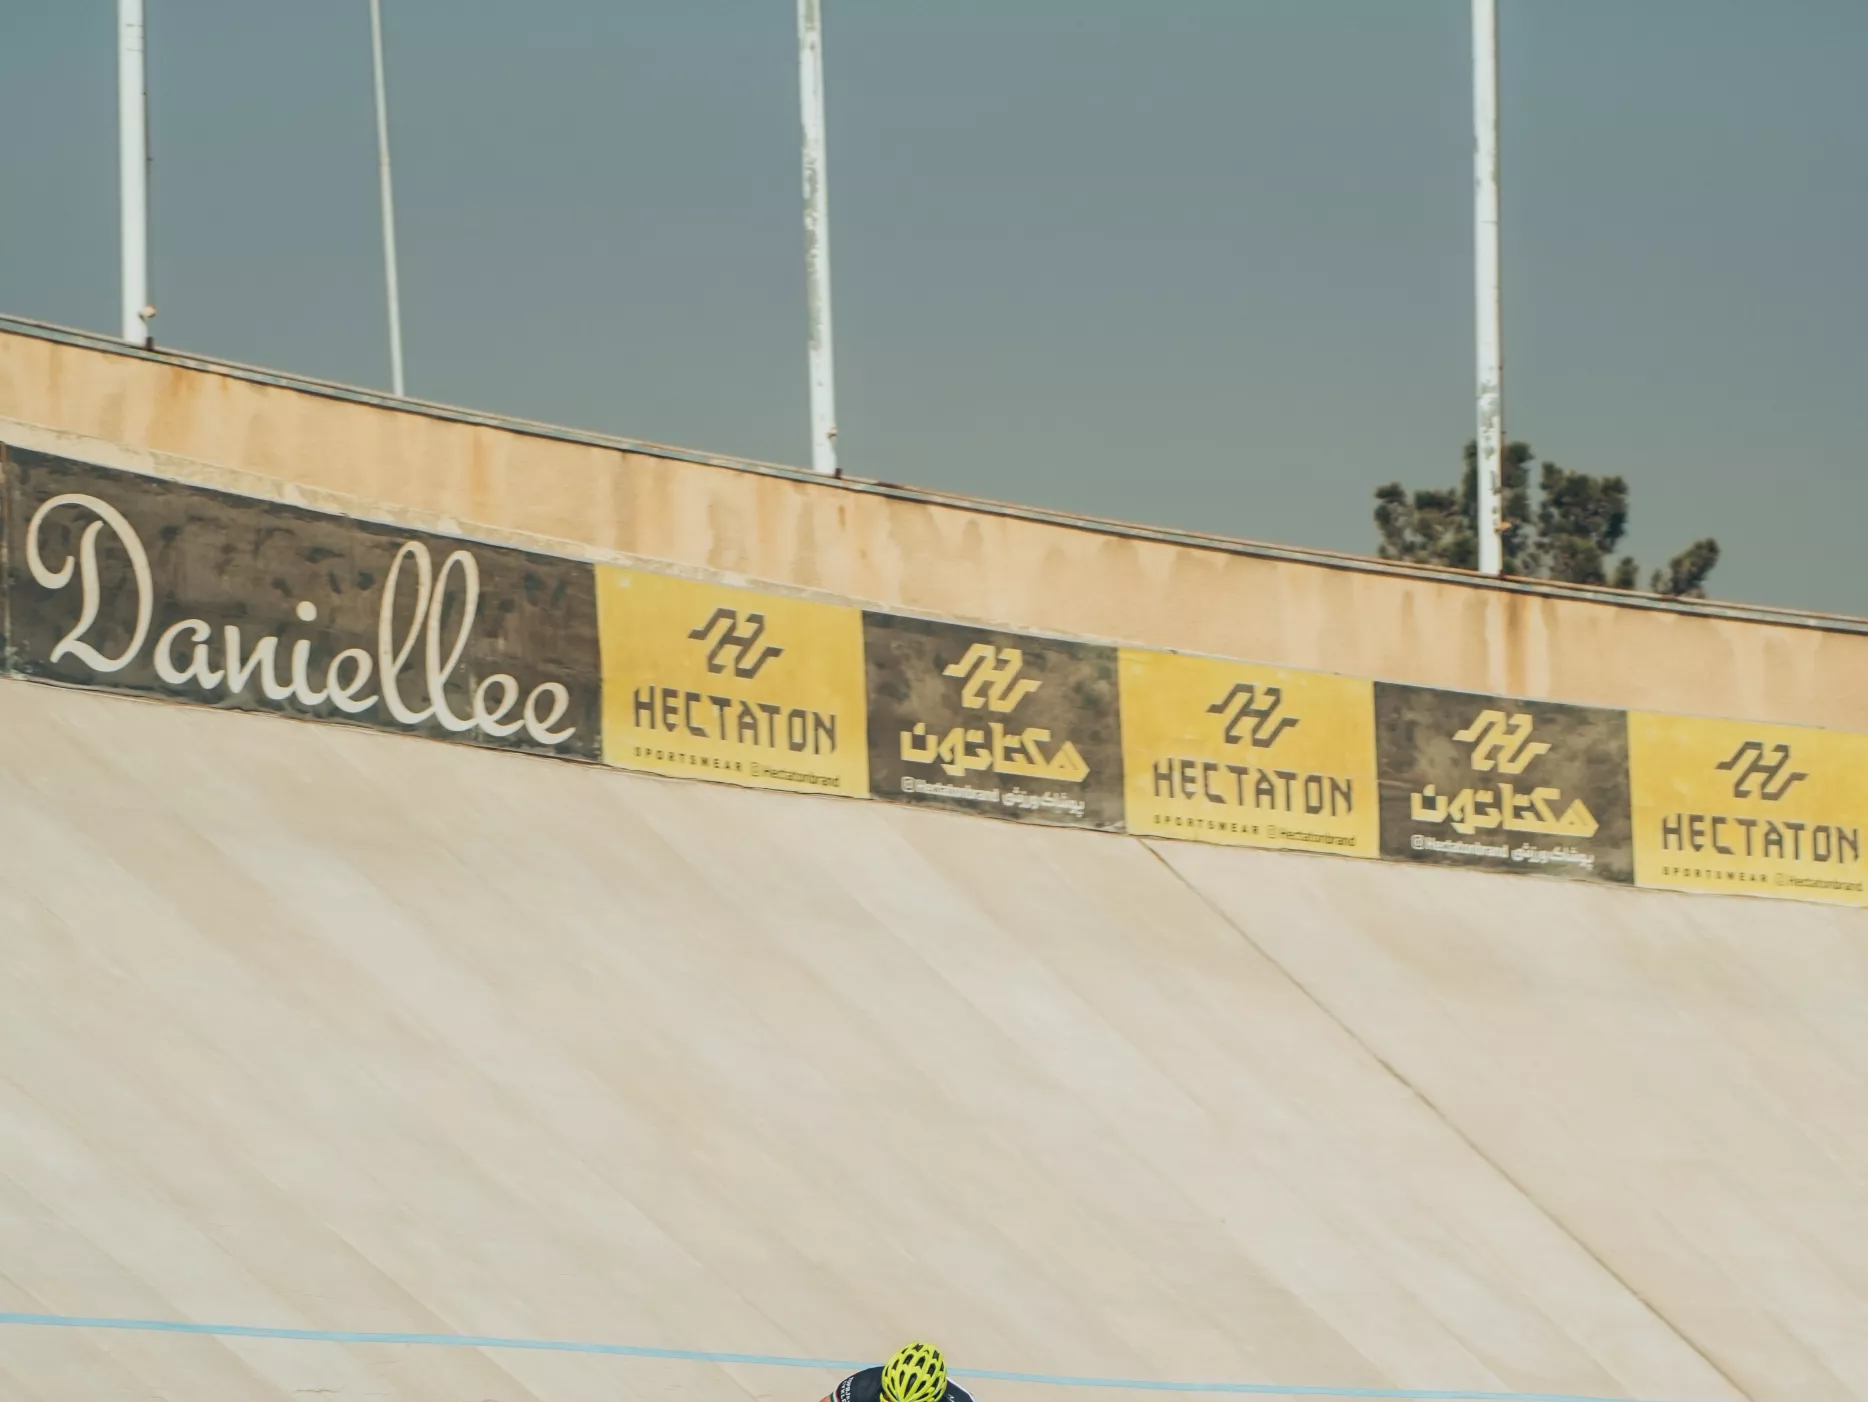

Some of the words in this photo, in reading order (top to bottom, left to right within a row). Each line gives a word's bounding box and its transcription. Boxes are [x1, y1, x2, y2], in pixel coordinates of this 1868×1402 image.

[26, 493, 576, 744] Daniellee
[633, 685, 837, 755] HECTATON
[634, 746, 742, 772] SPORTSWEAR
[1153, 757, 1352, 817] HECTATON
[1154, 814, 1259, 835] SPORTSWEAR
[1662, 813, 1860, 864] HECTATON
[1662, 866, 1769, 883] SPORTSWEAR
